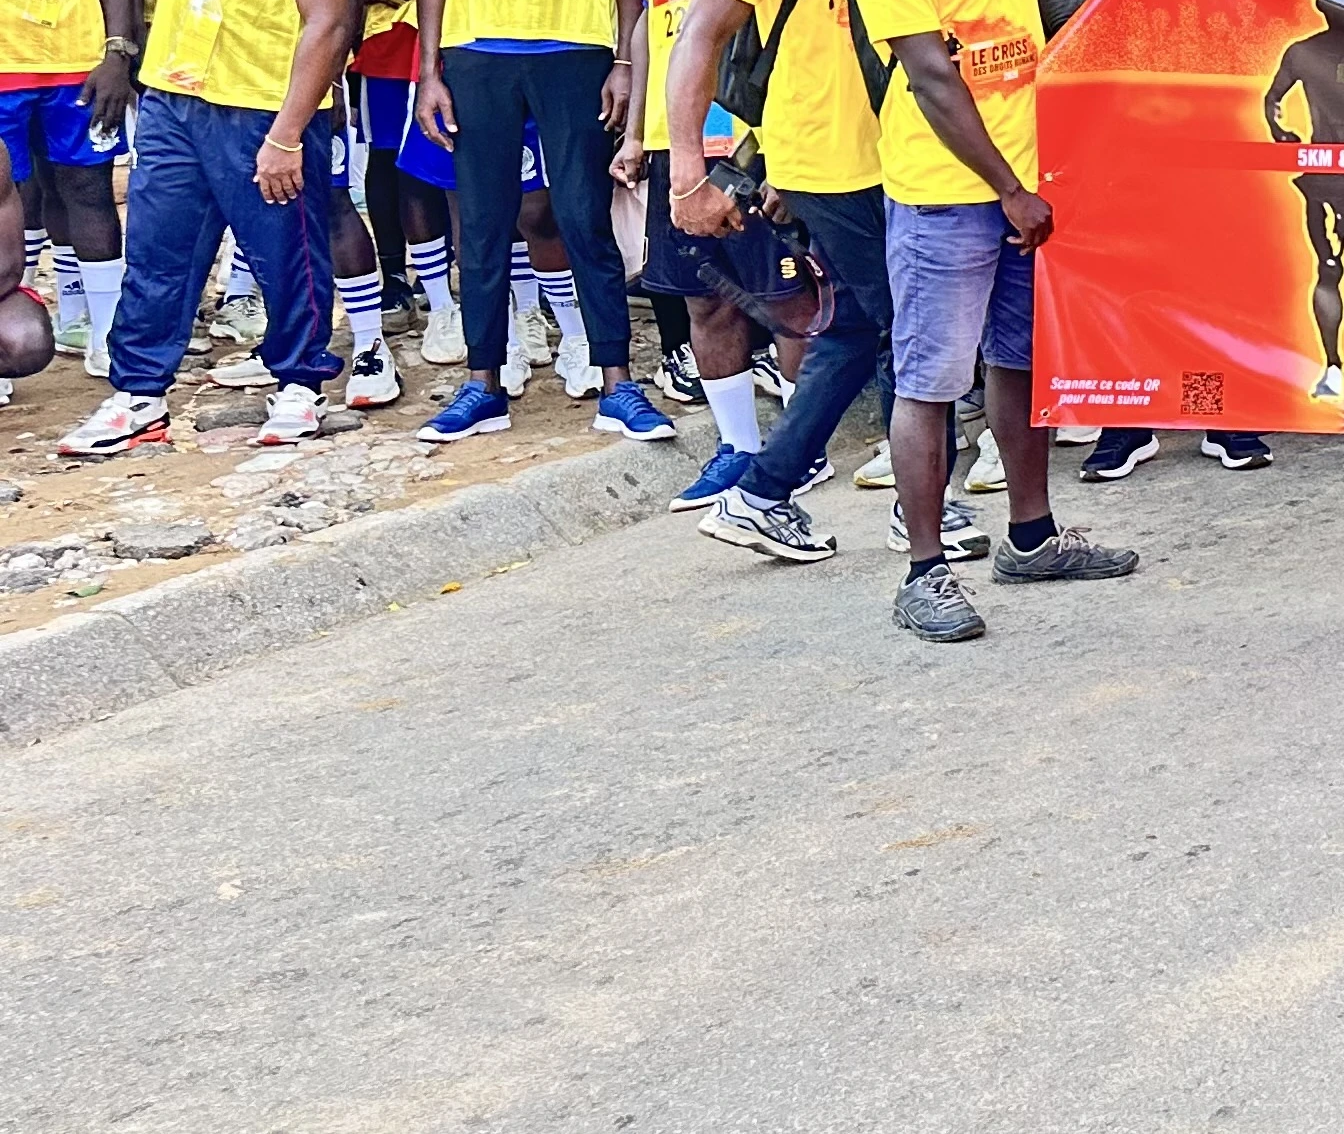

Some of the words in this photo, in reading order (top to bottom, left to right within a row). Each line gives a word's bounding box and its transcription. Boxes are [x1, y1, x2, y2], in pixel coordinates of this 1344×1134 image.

[971, 49, 987, 67] LE
[992, 38, 1028, 61] CROSS
[1297, 149, 1332, 167] 5KM
[1050, 376, 1099, 392] Scannez
[1100, 379, 1113, 391] ce
[1115, 377, 1141, 392] code
[1143, 377, 1161, 393] QR
[1058, 393, 1086, 407] pour
[1087, 393, 1115, 405] nous
[1117, 392, 1151, 407] suivre
